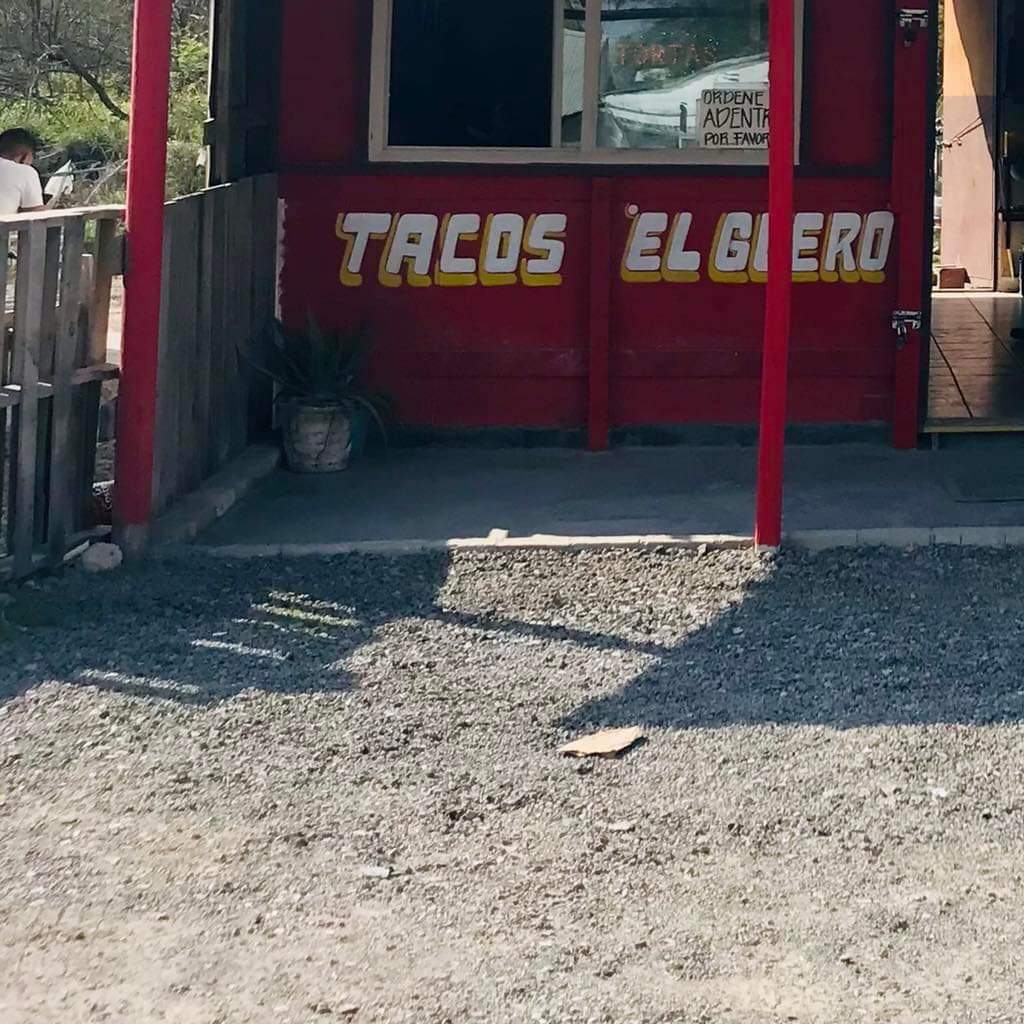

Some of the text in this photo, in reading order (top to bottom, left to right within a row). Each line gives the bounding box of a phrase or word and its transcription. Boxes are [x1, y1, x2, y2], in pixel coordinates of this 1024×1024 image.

[703, 89, 765, 106] ORDENE
[704, 131, 729, 146] POR
[335, 212, 568, 287] TACOS
[620, 211, 701, 283] EL
